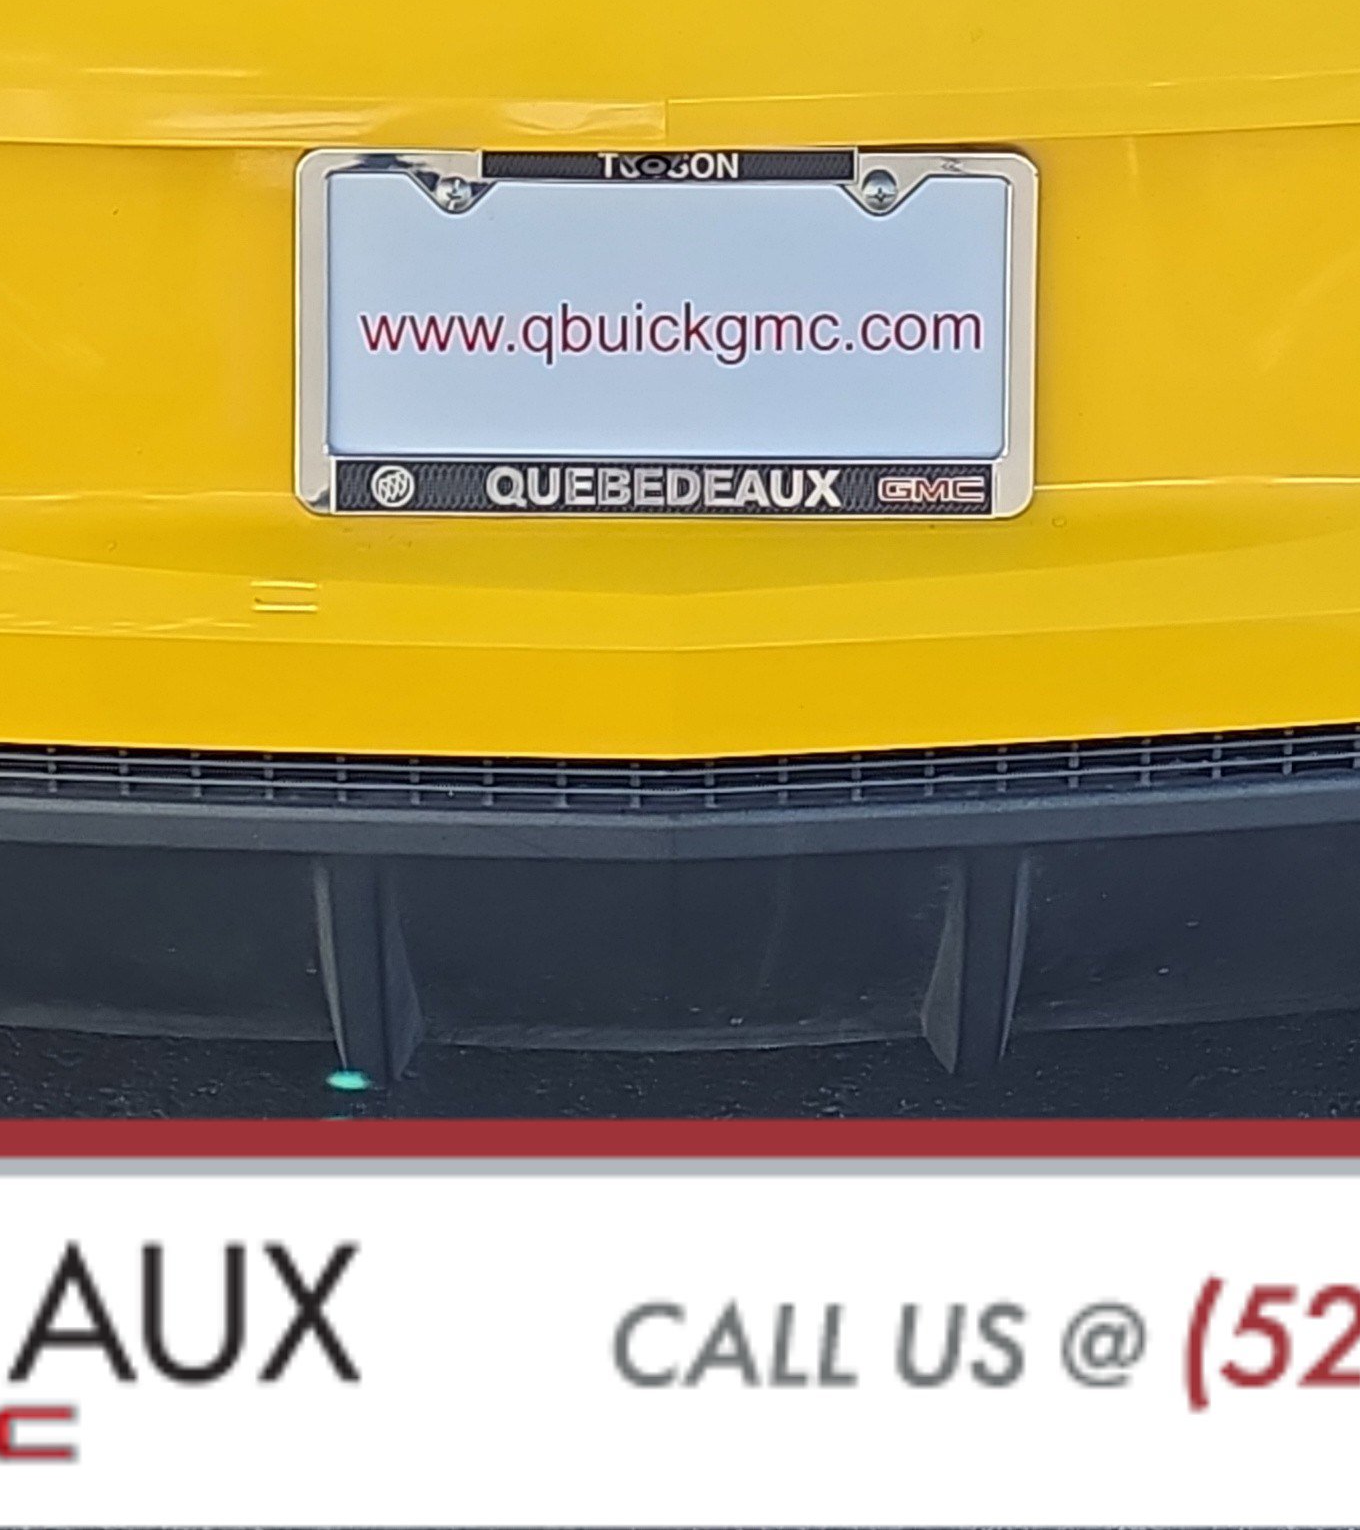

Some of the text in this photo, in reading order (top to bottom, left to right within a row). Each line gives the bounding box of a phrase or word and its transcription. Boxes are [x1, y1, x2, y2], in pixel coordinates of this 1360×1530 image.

[597, 152, 739, 179] TUSON
[360, 302, 982, 365] www.qbuickgmc.com
[486, 466, 986, 508] QUEBEDEAUX GMC
